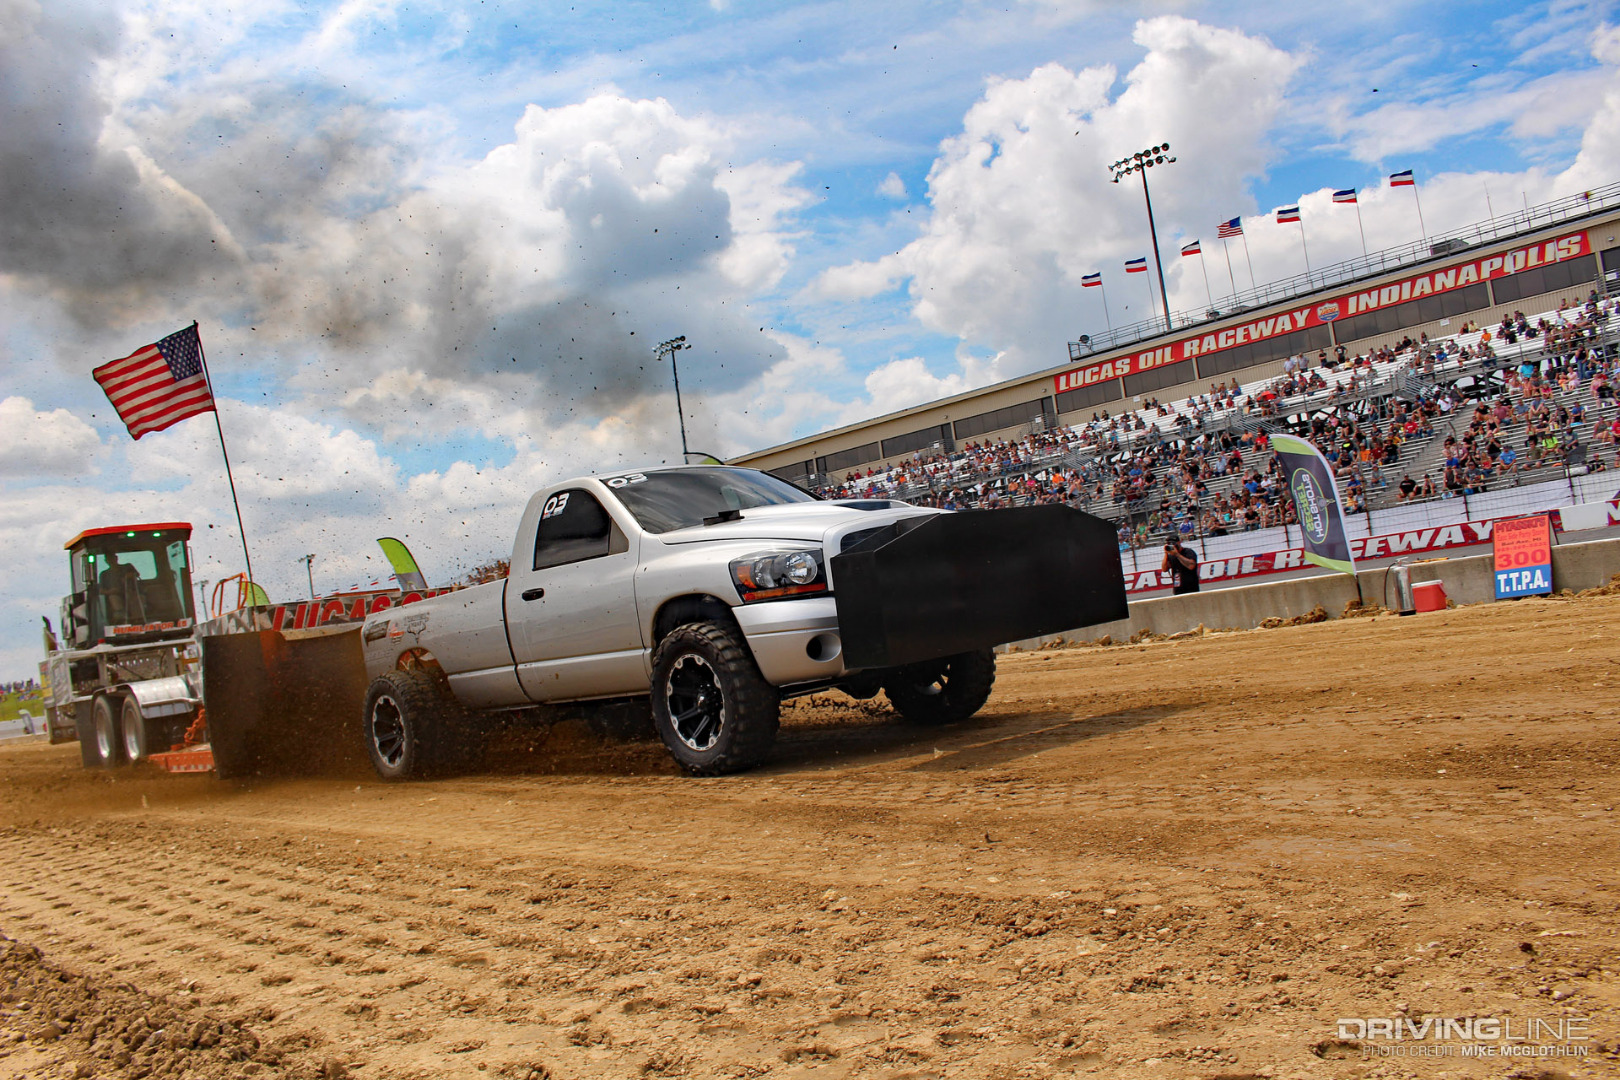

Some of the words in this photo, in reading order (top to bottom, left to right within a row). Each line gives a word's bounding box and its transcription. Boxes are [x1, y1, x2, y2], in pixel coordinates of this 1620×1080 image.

[1348, 235, 1582, 315] INDIANAPOLIS
[1059, 358, 1131, 392] LUCAS
[1138, 345, 1175, 370] OIL
[1183, 308, 1311, 358] RACEWAY
[607, 473, 648, 489] 03
[543, 492, 570, 516] 03
[1200, 555, 1259, 580] OIL
[1498, 549, 1546, 568] 300
[1497, 569, 1549, 593] T.T.P.A.
[113, 621, 174, 634] HUMILIATOR
